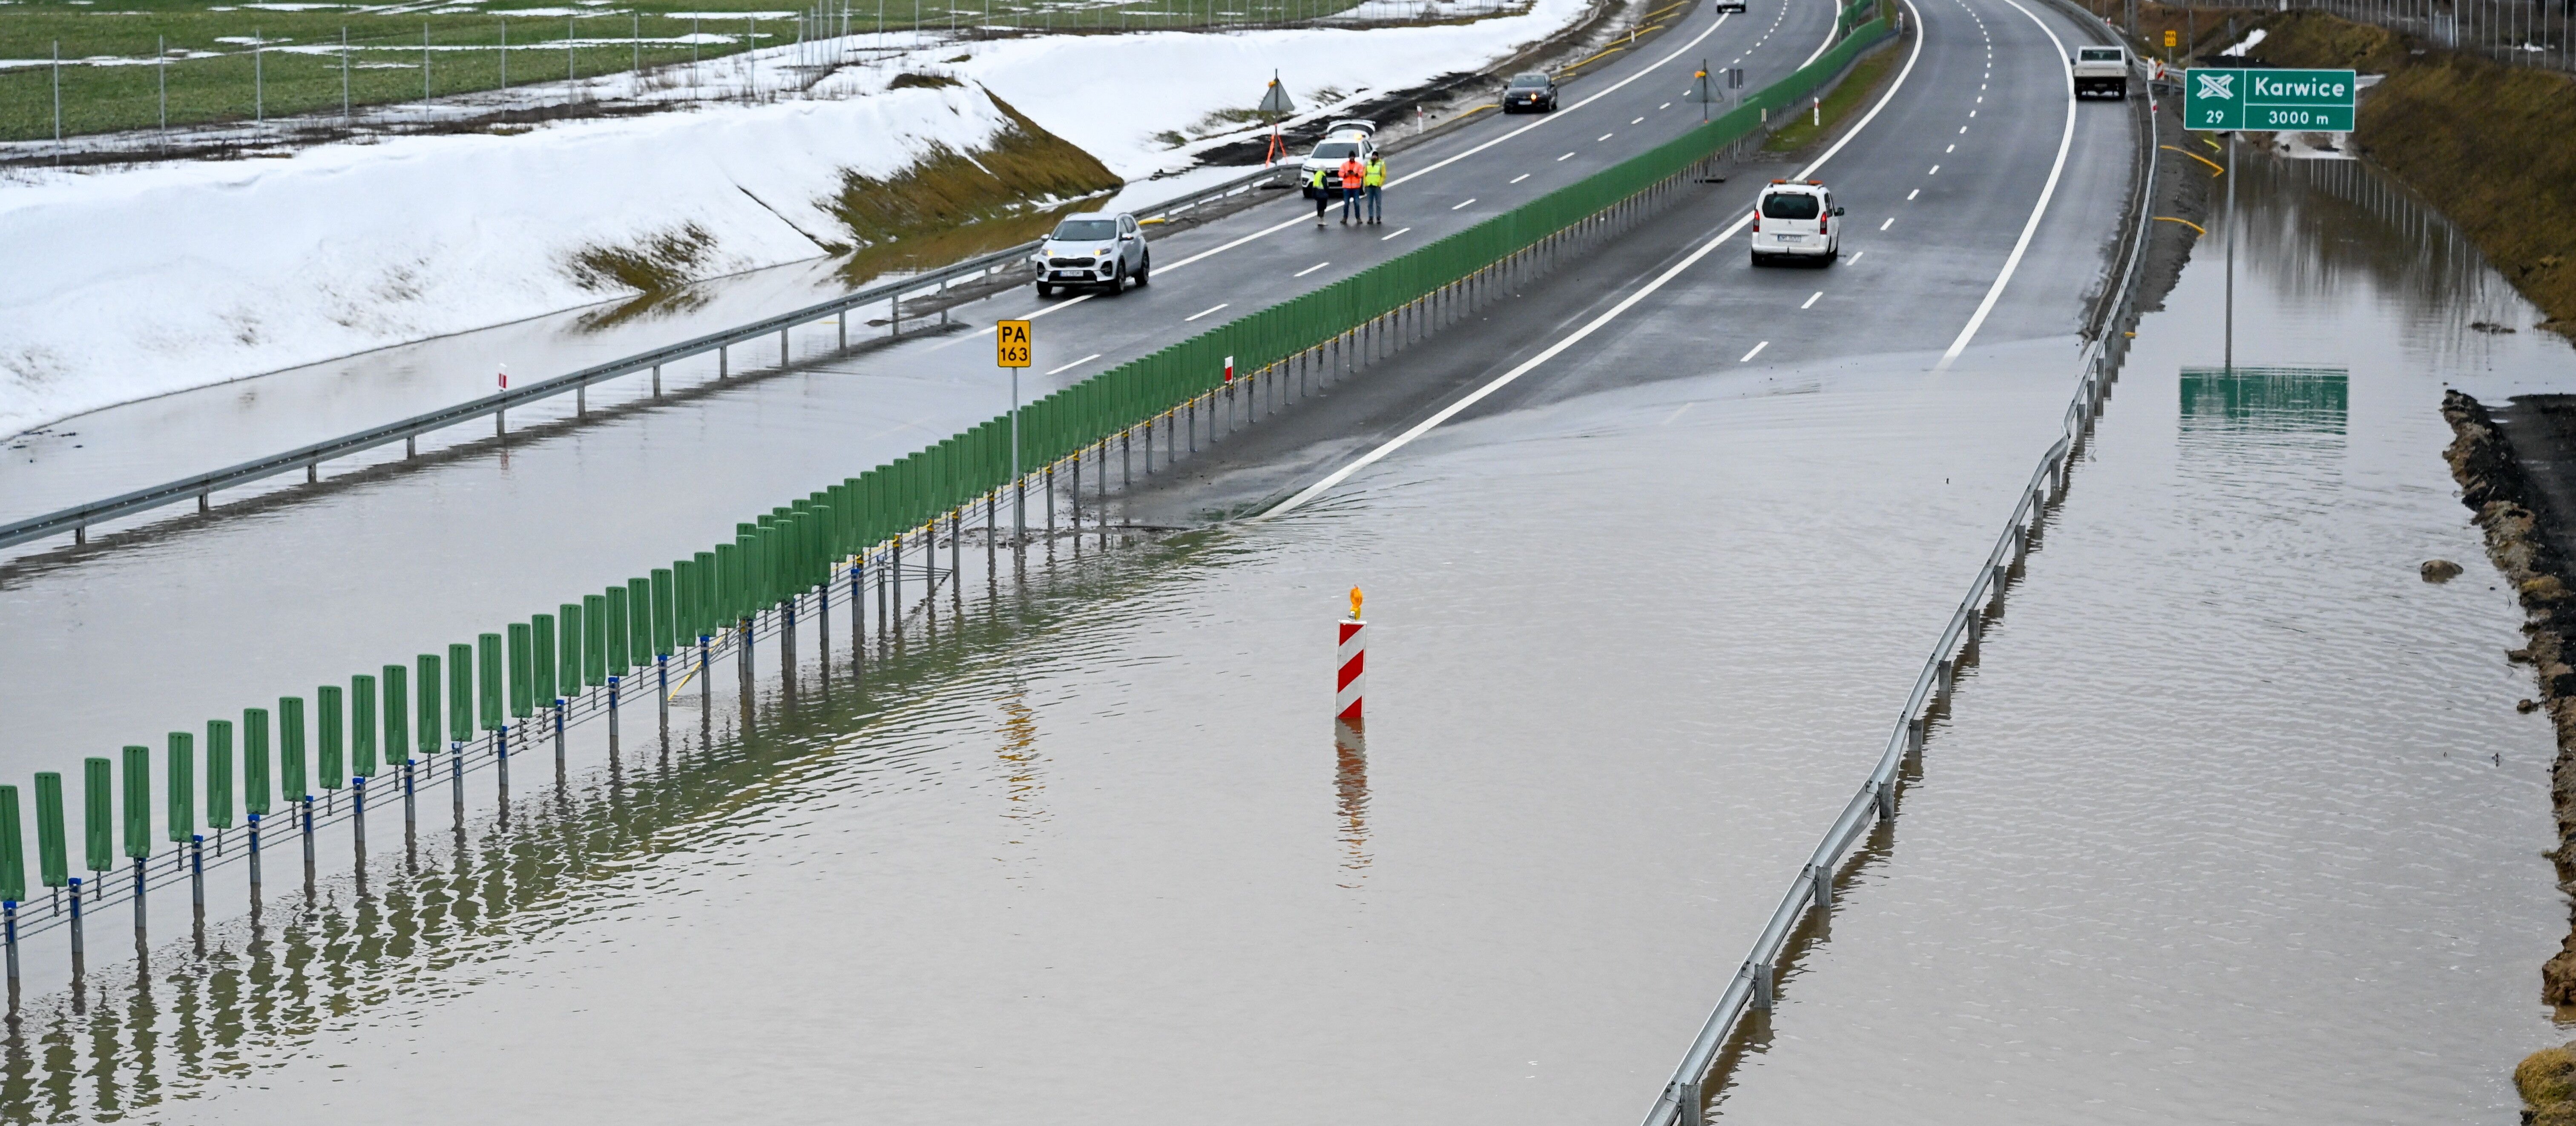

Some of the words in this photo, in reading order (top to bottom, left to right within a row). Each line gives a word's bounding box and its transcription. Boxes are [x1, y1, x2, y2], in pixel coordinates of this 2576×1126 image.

[2255, 77, 2345, 97] Karwice
[2206, 110, 2224, 124] 29
[2268, 111, 2309, 124] 3000
[2316, 115, 2329, 125] m
[1002, 326, 1026, 343] PA
[1000, 347, 1028, 362] 163
